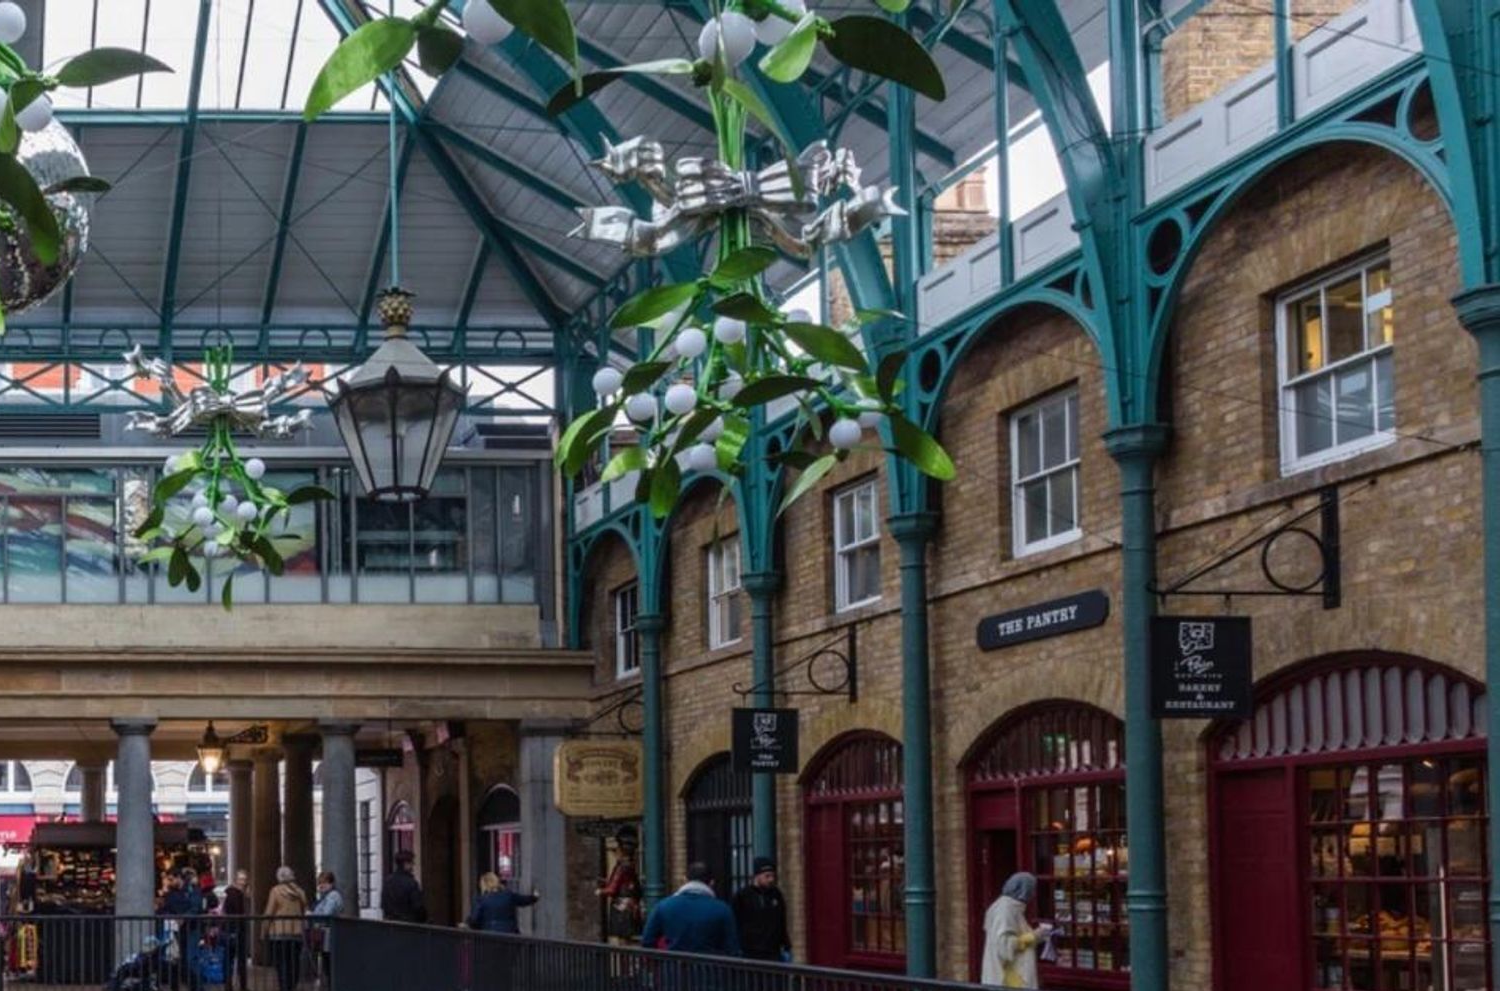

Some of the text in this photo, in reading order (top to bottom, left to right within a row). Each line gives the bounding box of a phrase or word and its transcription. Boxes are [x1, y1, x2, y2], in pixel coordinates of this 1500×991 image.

[998, 605, 1078, 636] THE PANTRY
[1179, 684, 1221, 692] BAKERY
[1165, 701, 1235, 709] RESTAURANT
